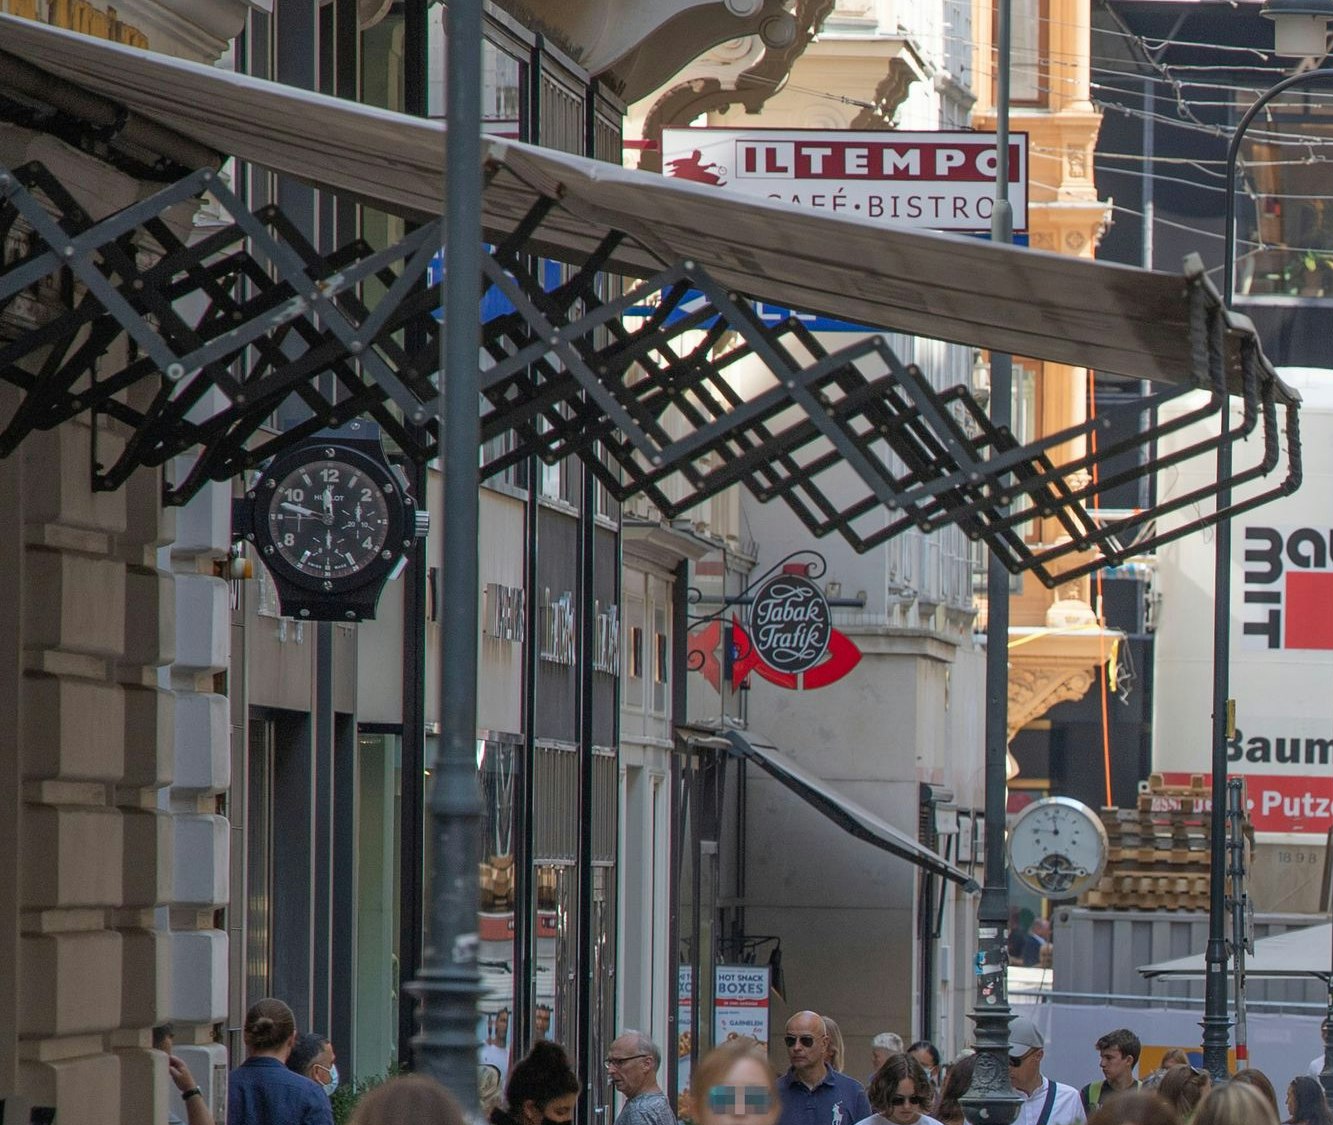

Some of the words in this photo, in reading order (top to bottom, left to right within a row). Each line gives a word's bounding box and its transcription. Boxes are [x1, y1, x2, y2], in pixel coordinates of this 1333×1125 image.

[744, 146, 789, 174] IL
[801, 147, 1009, 177] TEMPO
[868, 196, 994, 219] BISTRO
[319, 468, 340, 483] 12
[284, 488, 305, 502] 10
[360, 488, 373, 502] 2
[284, 532, 295, 547] 8
[361, 536, 374, 550] 4
[757, 593, 824, 625] Tabak
[758, 623, 824, 660] Trafik
[718, 982, 764, 994] BOXES
